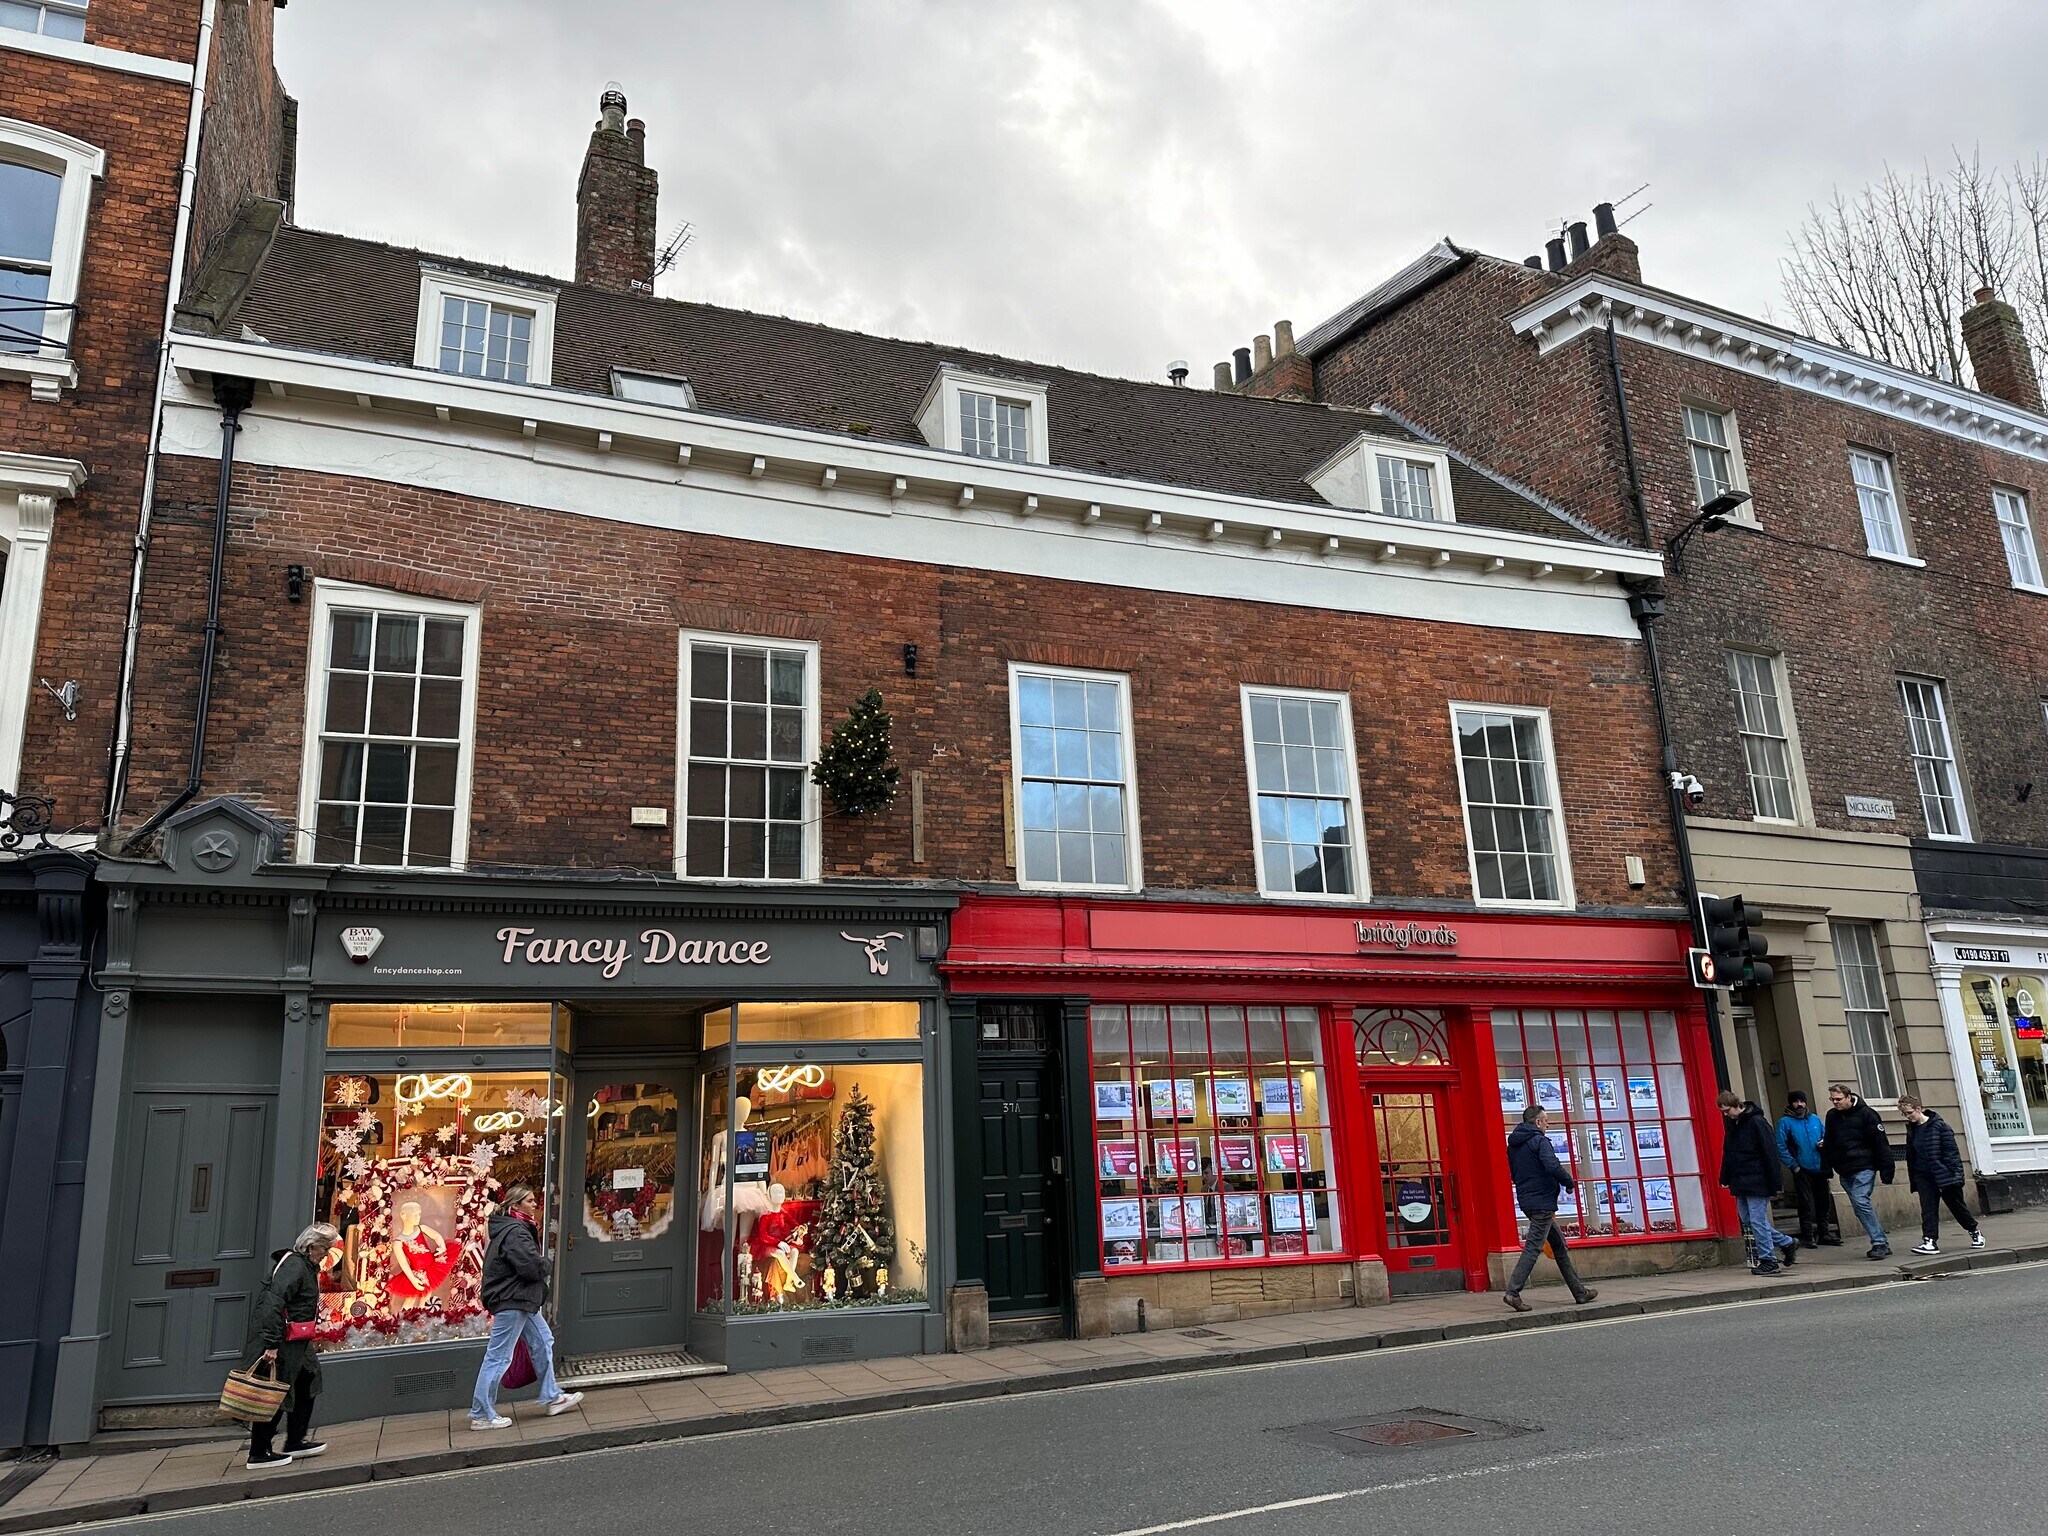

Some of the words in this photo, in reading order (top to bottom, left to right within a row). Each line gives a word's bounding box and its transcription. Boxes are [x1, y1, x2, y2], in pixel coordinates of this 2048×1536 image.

[1848, 802, 1893, 815] MICKLEGATE
[1354, 920, 1458, 950] bridgfords
[496, 927, 632, 979] Fancy
[640, 929, 772, 964] Dance
[2001, 951, 2009, 962] 17
[373, 966, 463, 976] fancydanceshop.com
[1003, 1102, 1021, 1113] 37A
[1986, 1122, 2025, 1131] LTERATIONS
